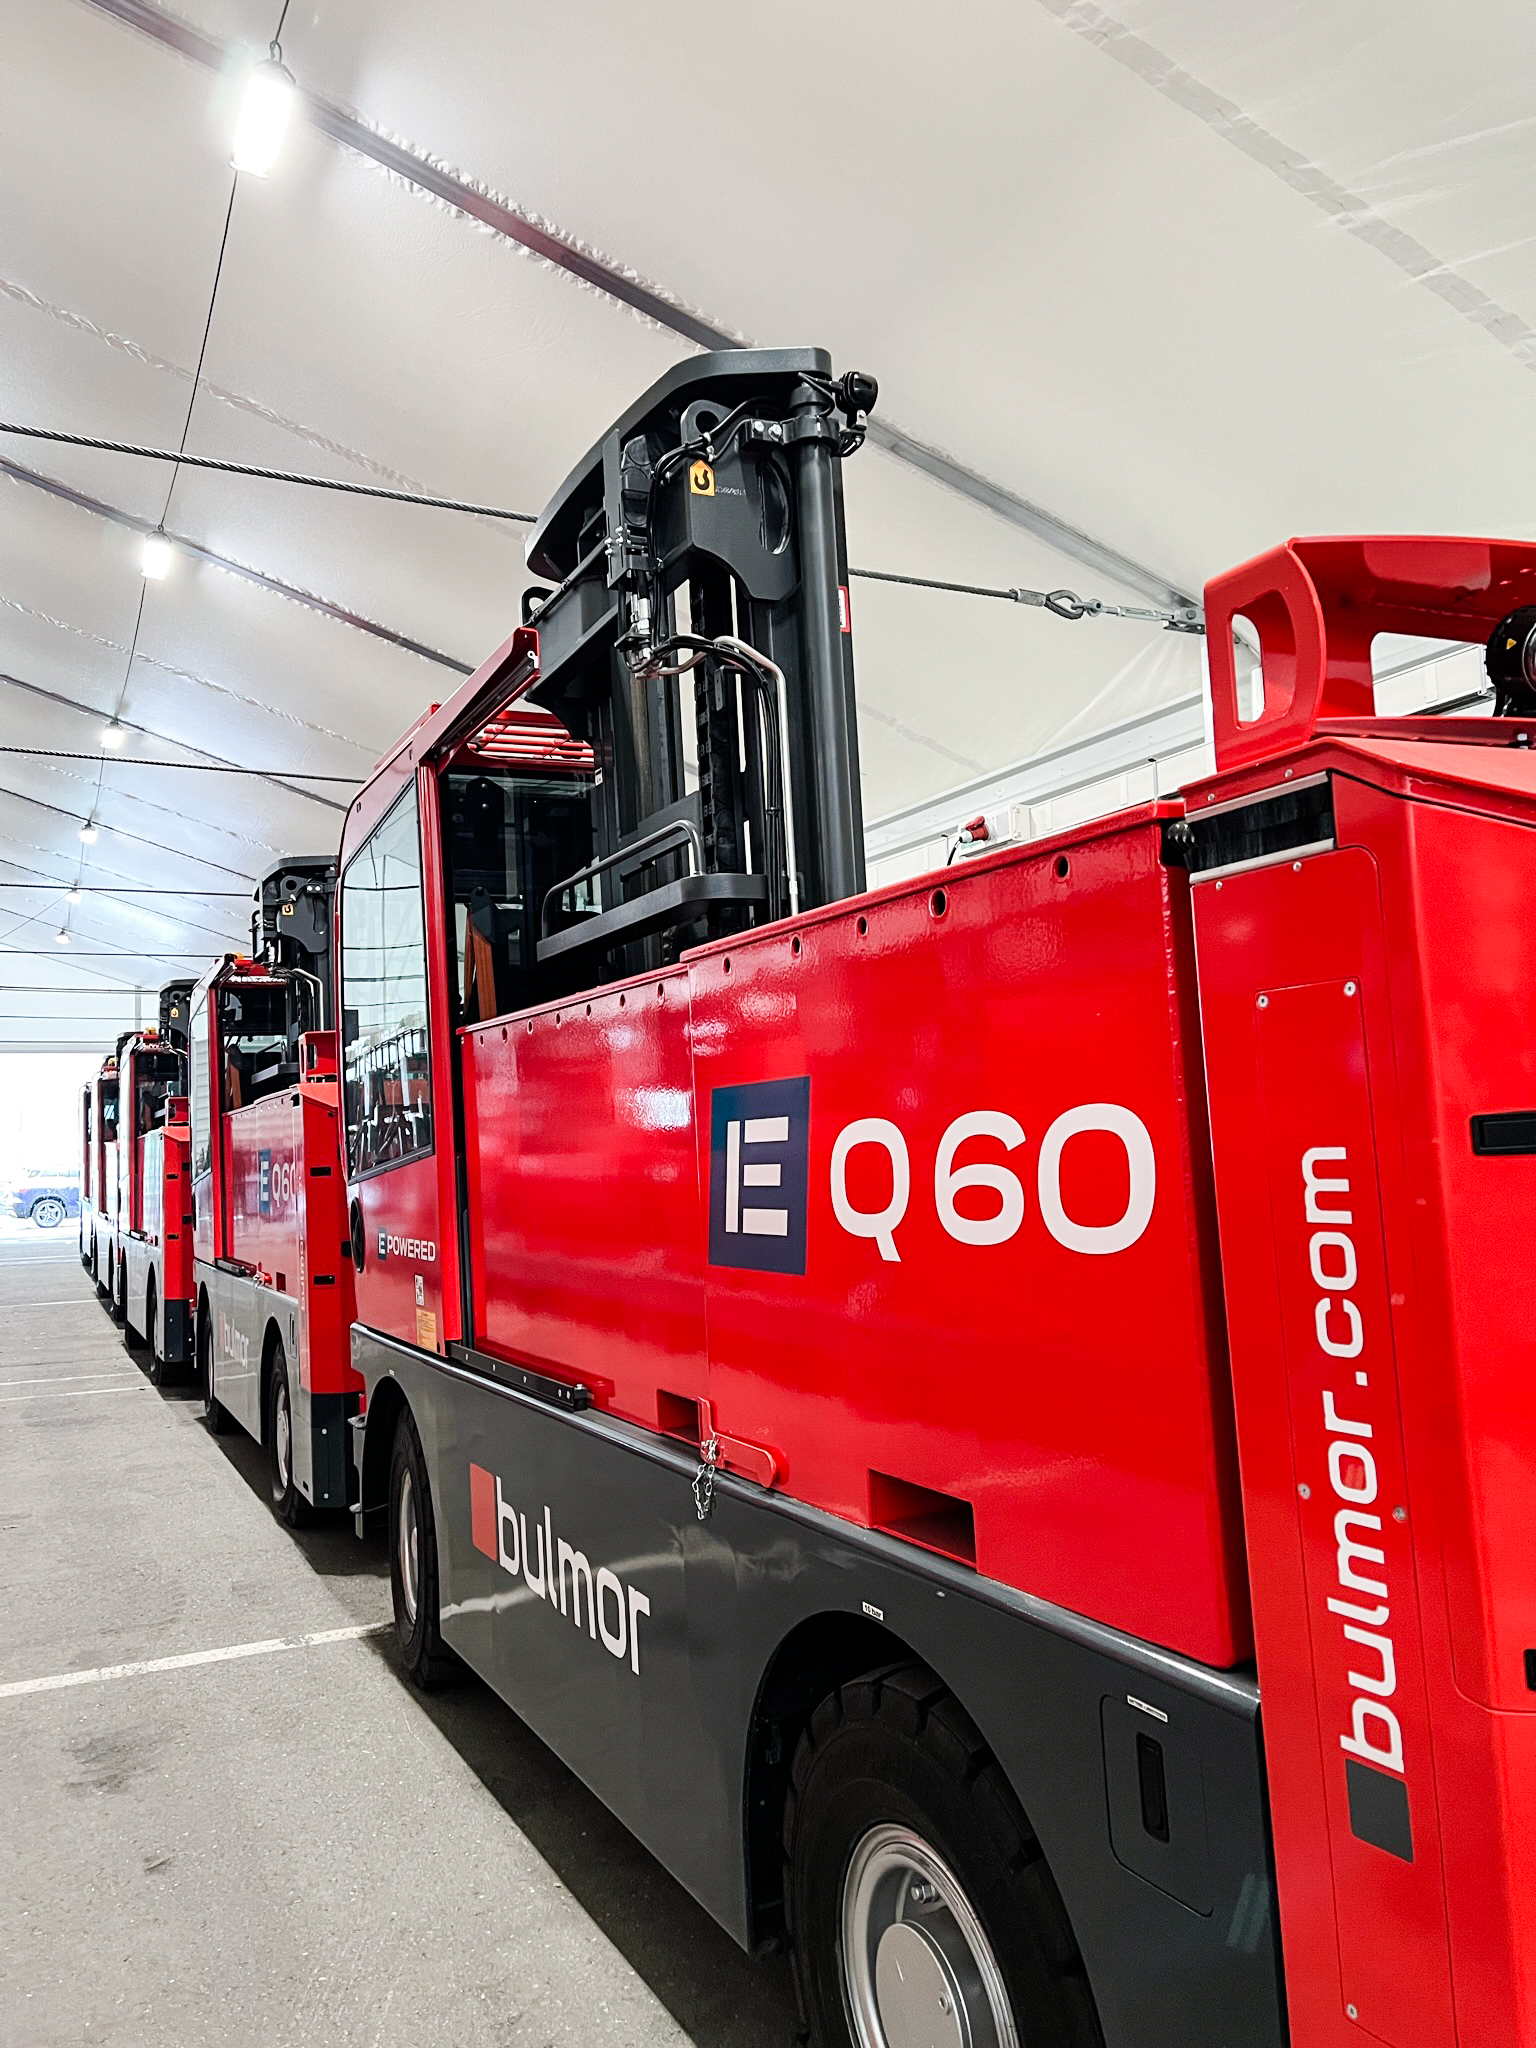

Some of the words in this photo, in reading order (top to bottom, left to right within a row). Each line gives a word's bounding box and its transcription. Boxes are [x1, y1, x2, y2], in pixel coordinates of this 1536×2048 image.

[387, 1235, 436, 1262] POWERED
[1301, 1145, 1406, 1774] bulmor.com
[495, 1475, 651, 1676] bulmor
